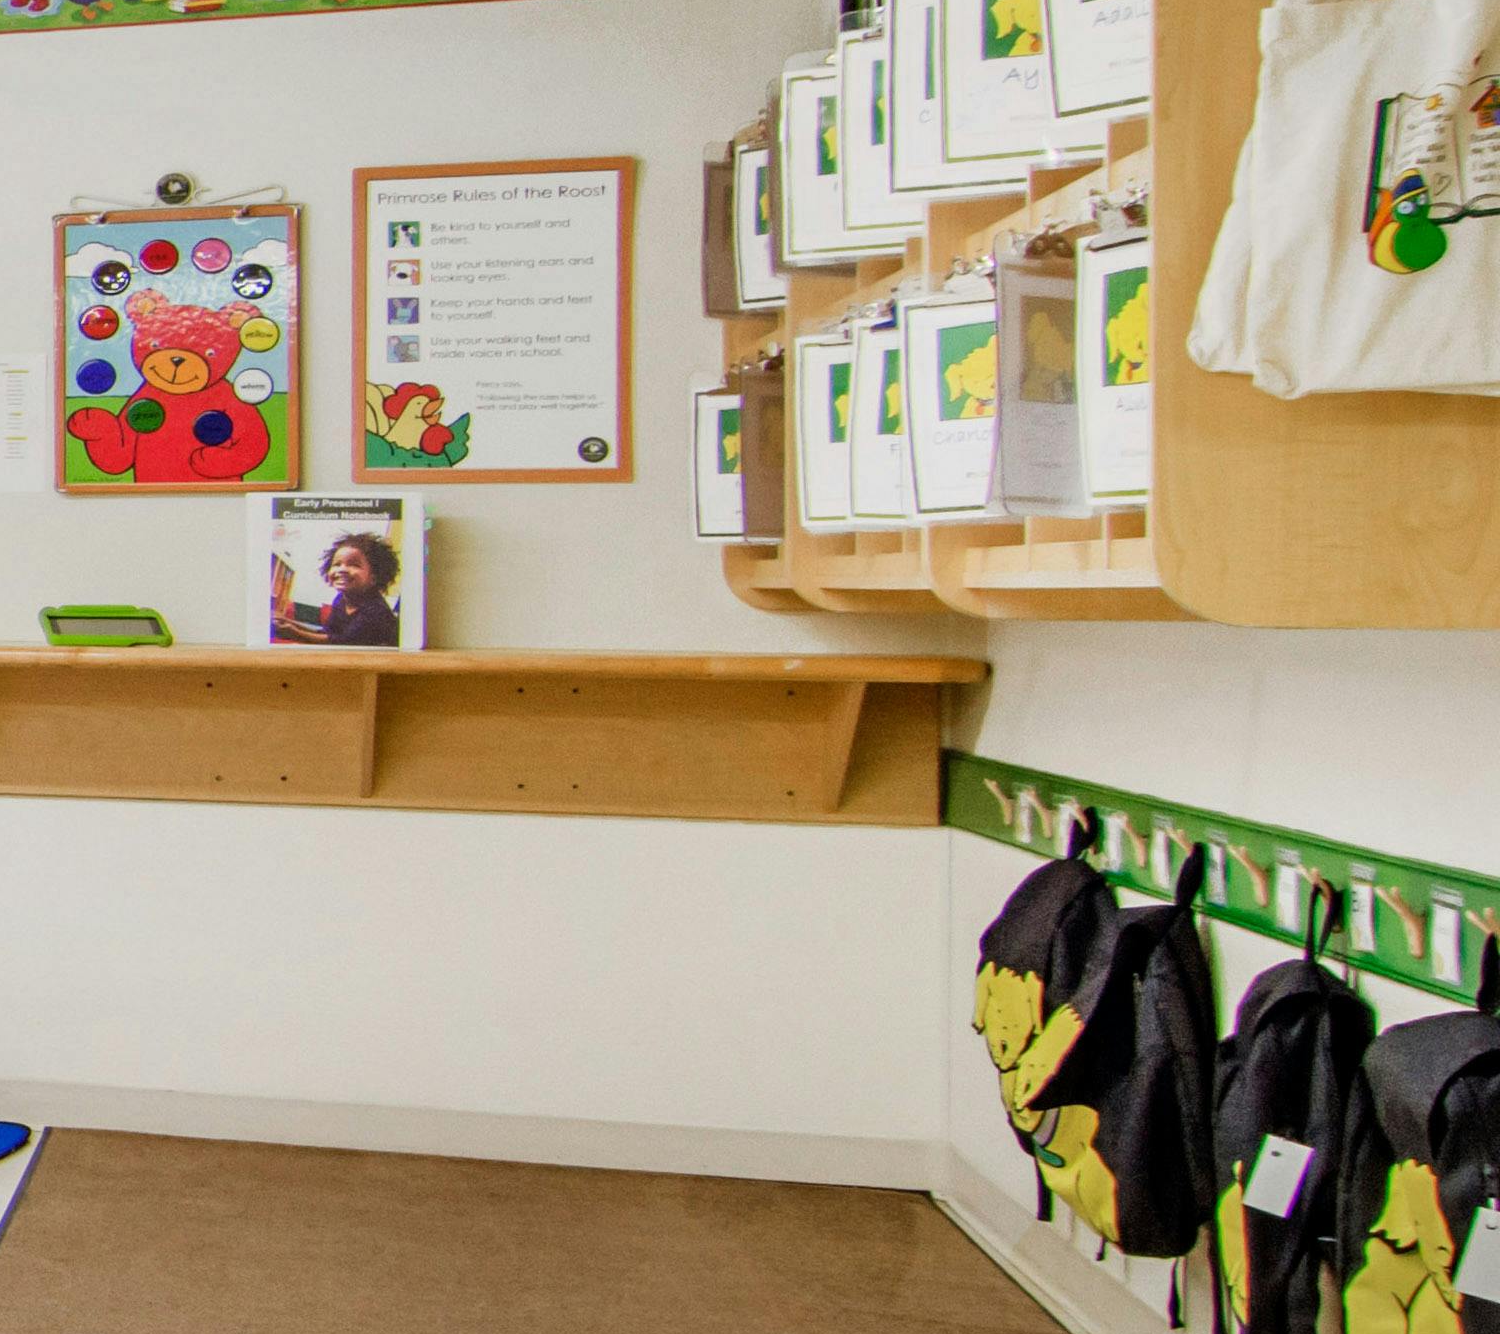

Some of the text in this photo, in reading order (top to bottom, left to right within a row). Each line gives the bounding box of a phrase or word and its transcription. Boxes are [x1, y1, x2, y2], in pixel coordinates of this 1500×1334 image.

[377, 184, 606, 206] Primrose Rules of the Roost
[545, 219, 571, 229] and
[294, 498, 319, 509] Early
[322, 498, 373, 508] Preschool
[283, 511, 390, 520] Curriculum Notebook
